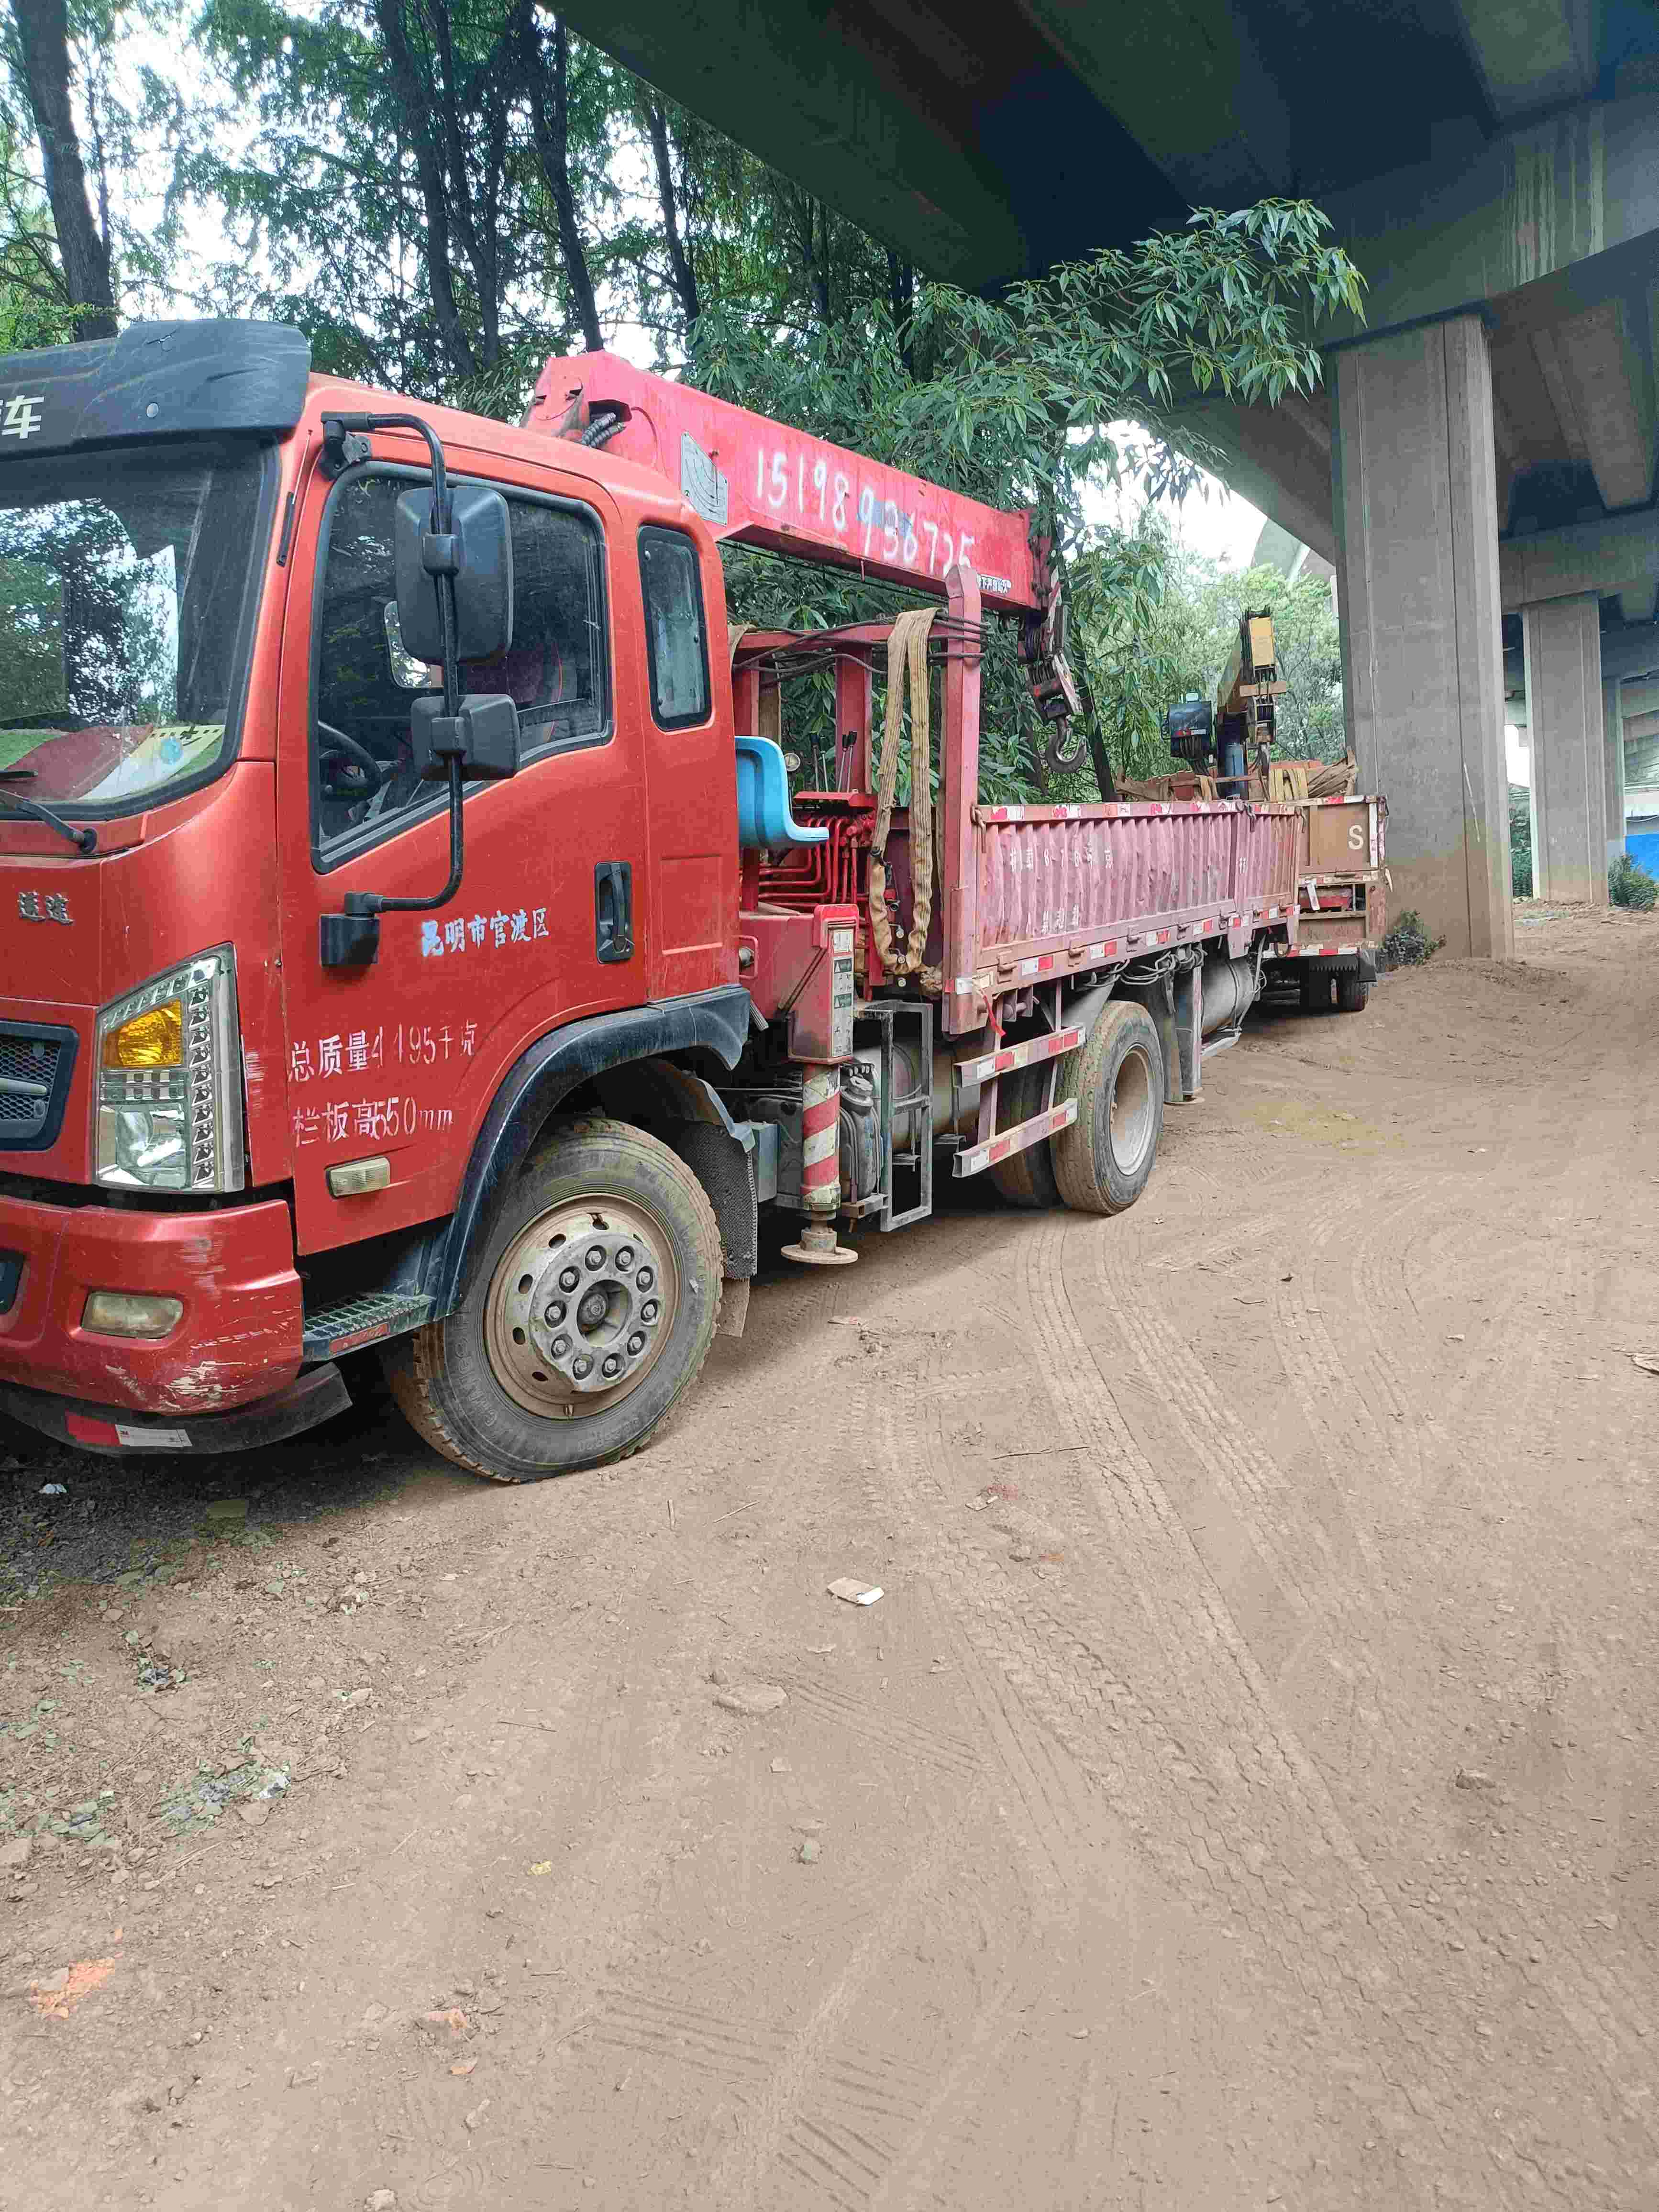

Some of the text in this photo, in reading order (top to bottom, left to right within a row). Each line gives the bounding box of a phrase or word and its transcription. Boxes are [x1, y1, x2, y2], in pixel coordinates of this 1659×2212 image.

[0, 395, 44, 439] 车
[1349, 825, 1364, 850] S
[421, 907, 549, 957] 昆明市官渡区
